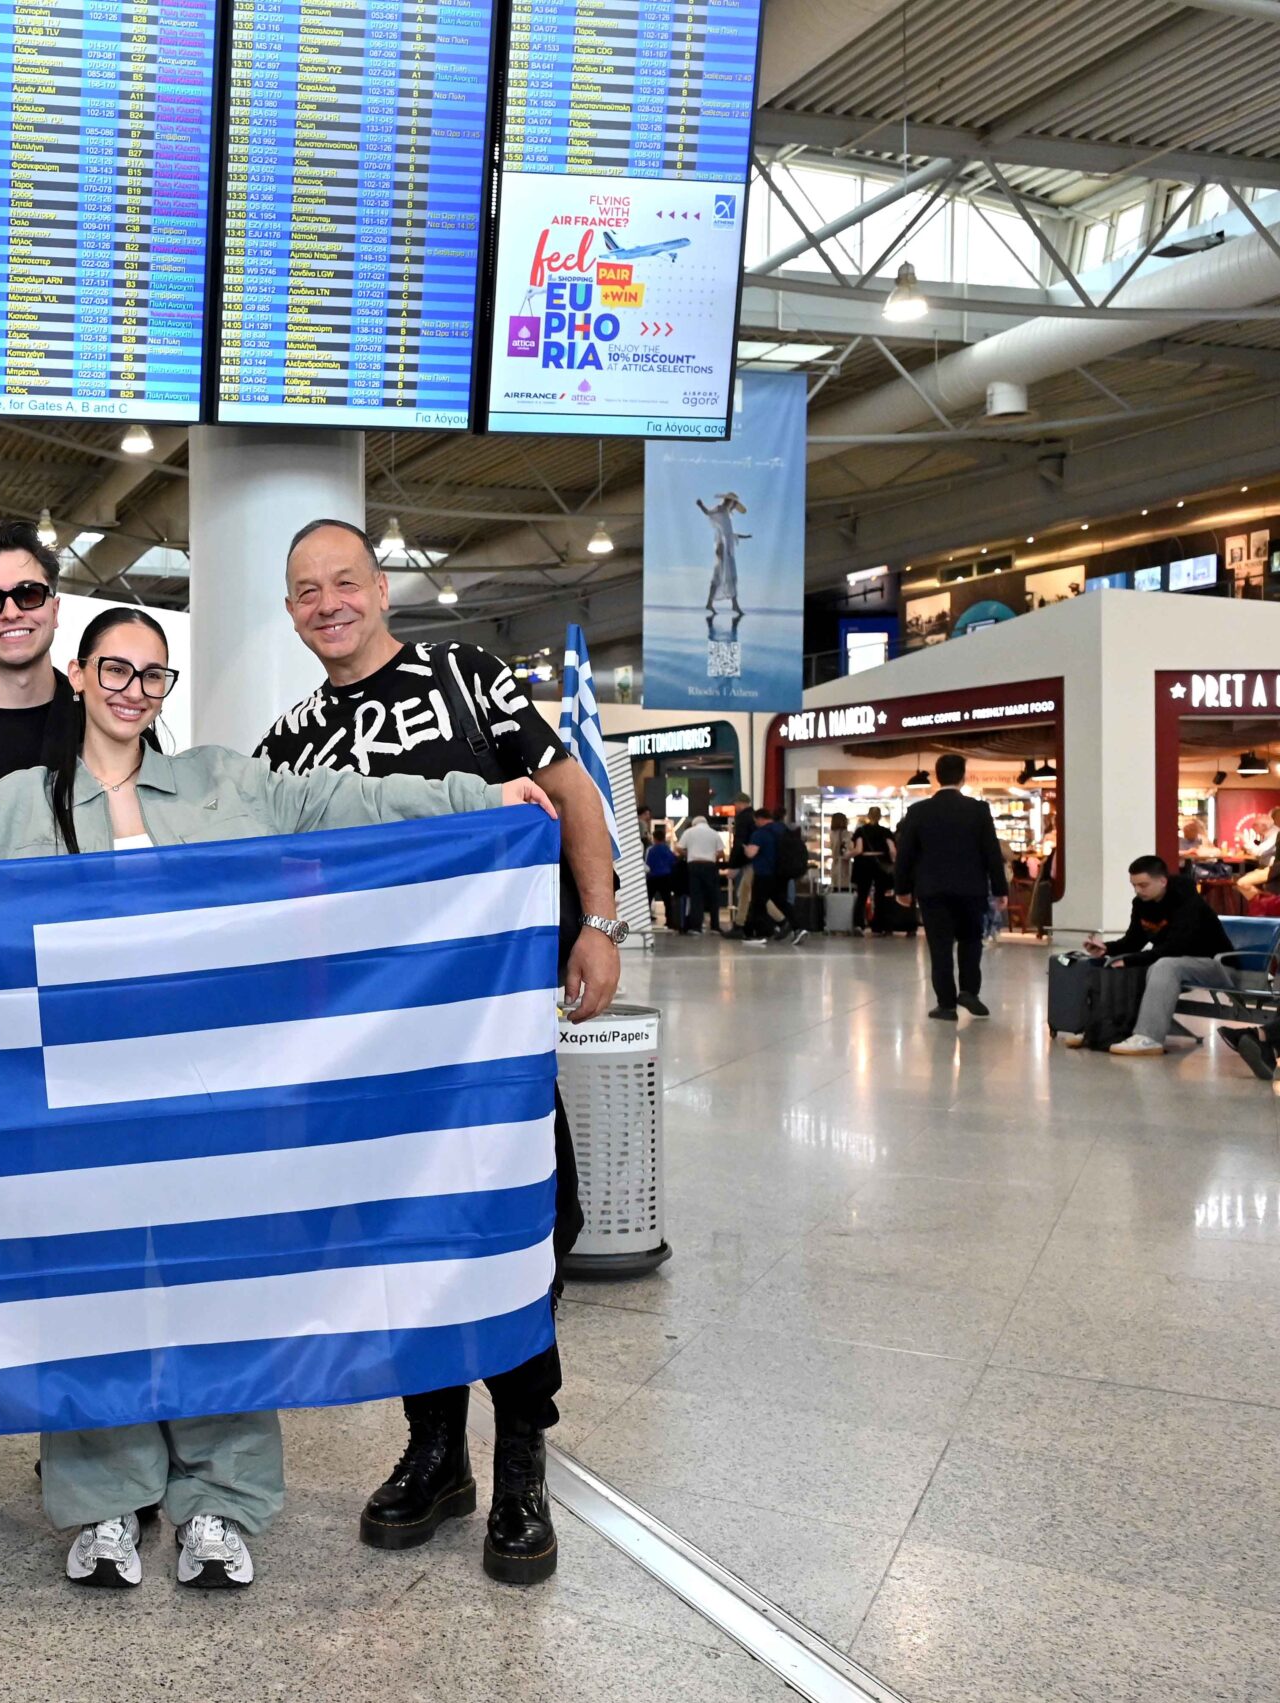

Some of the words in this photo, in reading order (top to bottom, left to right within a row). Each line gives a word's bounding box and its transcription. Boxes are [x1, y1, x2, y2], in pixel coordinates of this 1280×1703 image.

[512, 42, 529, 50] 15:05
[596, 47, 613, 55] CDG
[232, 79, 251, 87] 13:15
[265, 81, 278, 89] 292
[363, 181, 390, 189] 102-126
[590, 195, 630, 207] FLYING
[598, 207, 629, 217] WITH
[551, 215, 572, 226] AIR
[574, 216, 629, 228] FRANCE?
[529, 228, 596, 287] feel
[289, 269, 316, 277] Λονδίνο
[317, 270, 335, 278] LGW
[358, 272, 385, 280] 017-021
[599, 269, 630, 280] PAIR
[546, 282, 593, 311] EU
[544, 311, 620, 342] PHO
[608, 344, 639, 352] ENJOY
[643, 345, 660, 353] THE
[542, 341, 603, 370] RIA
[608, 352, 630, 362] 10%
[354, 362, 381, 370] 102-126
[607, 363, 617, 371] AT
[621, 364, 654, 372] ATTICA
[656, 365, 713, 374] SELECTIONS
[6, 387, 28, 395] Ρόδος
[77, 389, 105, 397] 070-078
[284, 396, 310, 404] Λονδίνο
[571, 394, 596, 402] attica
[9, 399, 23, 409] for
[29, 400, 63, 411] Gates
[82, 403, 89, 412] B
[94, 403, 115, 413] and
[119, 404, 127, 414] C
[416, 412, 431, 422] Για
[647, 422, 662, 432] Για
[665, 422, 701, 435] λόγους
[1191, 674, 1246, 707] PRET
[1252, 674, 1267, 707] A
[1005, 703, 1029, 715] MADE
[1030, 701, 1054, 713] FOOD
[817, 711, 827, 738] A
[559, 1030, 649, 1045] Χαρτιά/Papers
